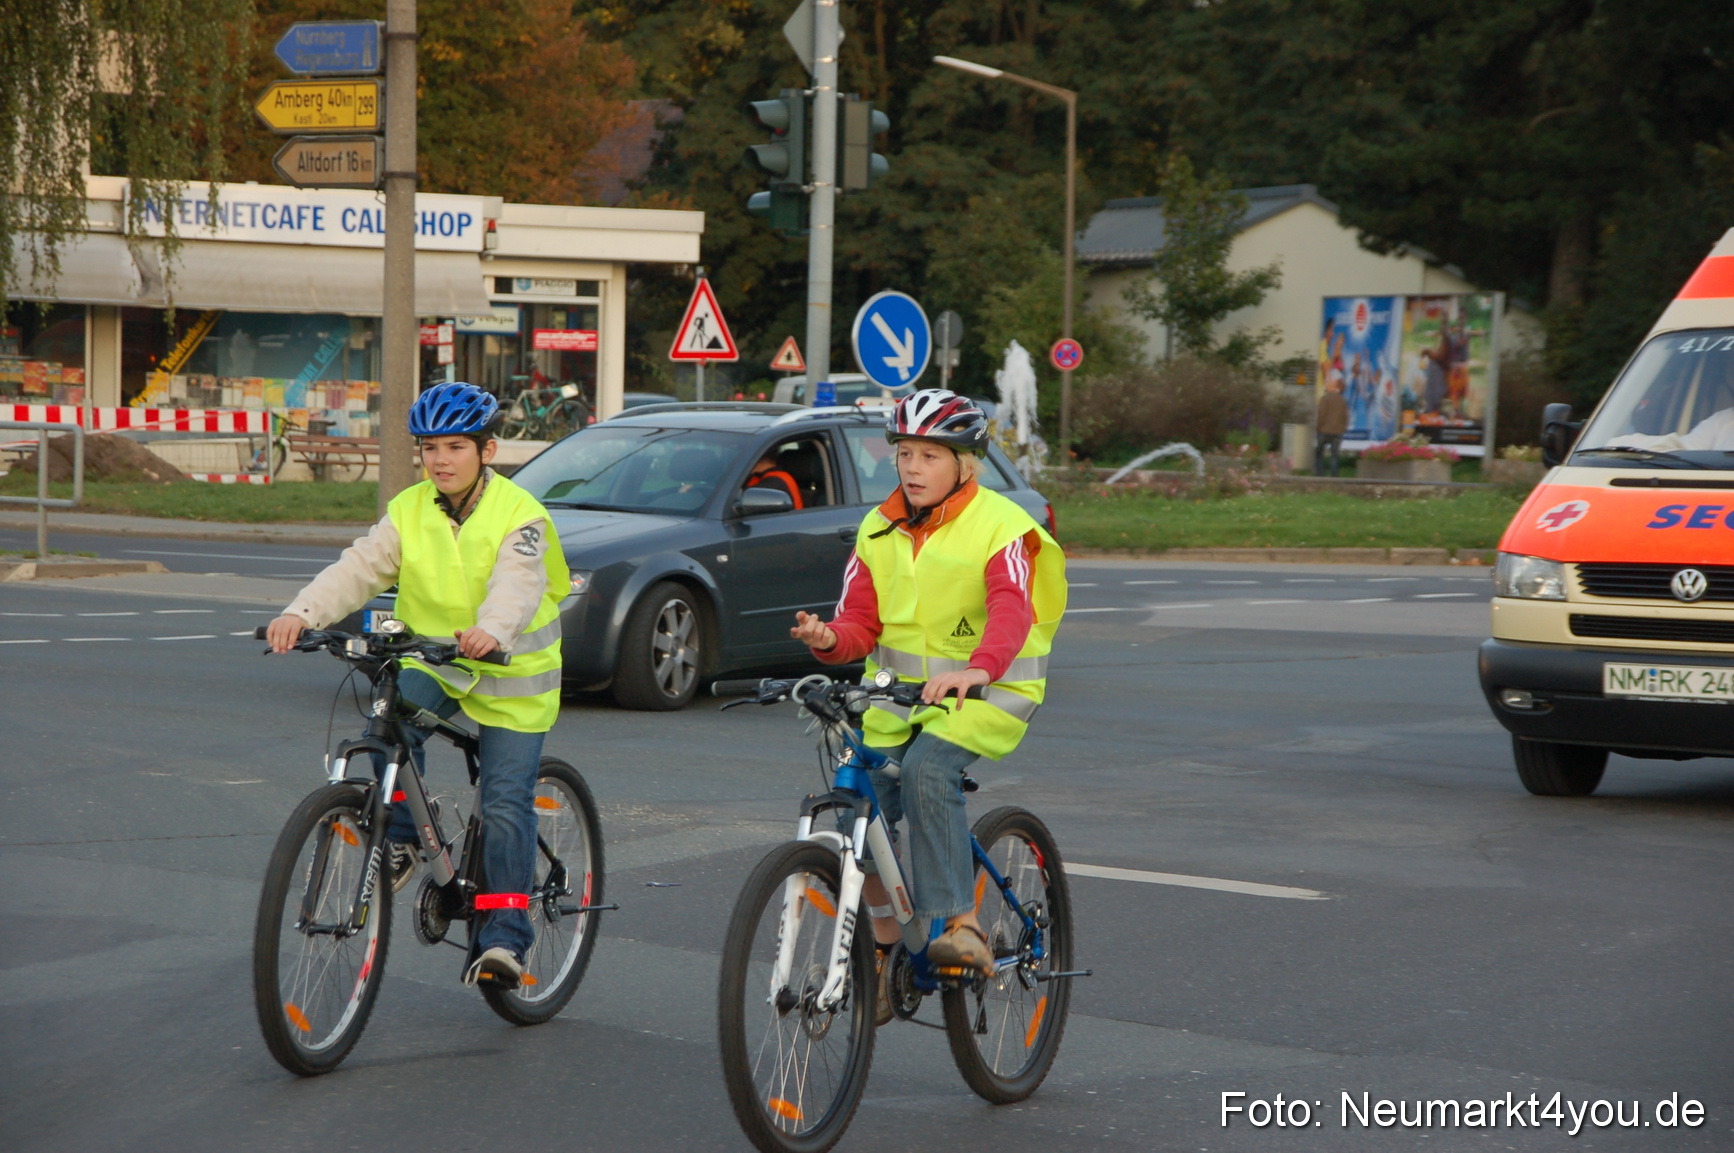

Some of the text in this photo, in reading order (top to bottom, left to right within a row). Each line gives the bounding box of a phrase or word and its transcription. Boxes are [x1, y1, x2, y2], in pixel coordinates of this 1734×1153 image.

[275, 88, 323, 112] Amberg
[358, 95, 374, 115] 299
[298, 151, 343, 172] Altdorf
[136, 198, 473, 237] NERNETCAFE CAL HOP
[1609, 668, 1646, 691] NM
[1660, 670, 1693, 694] RK
